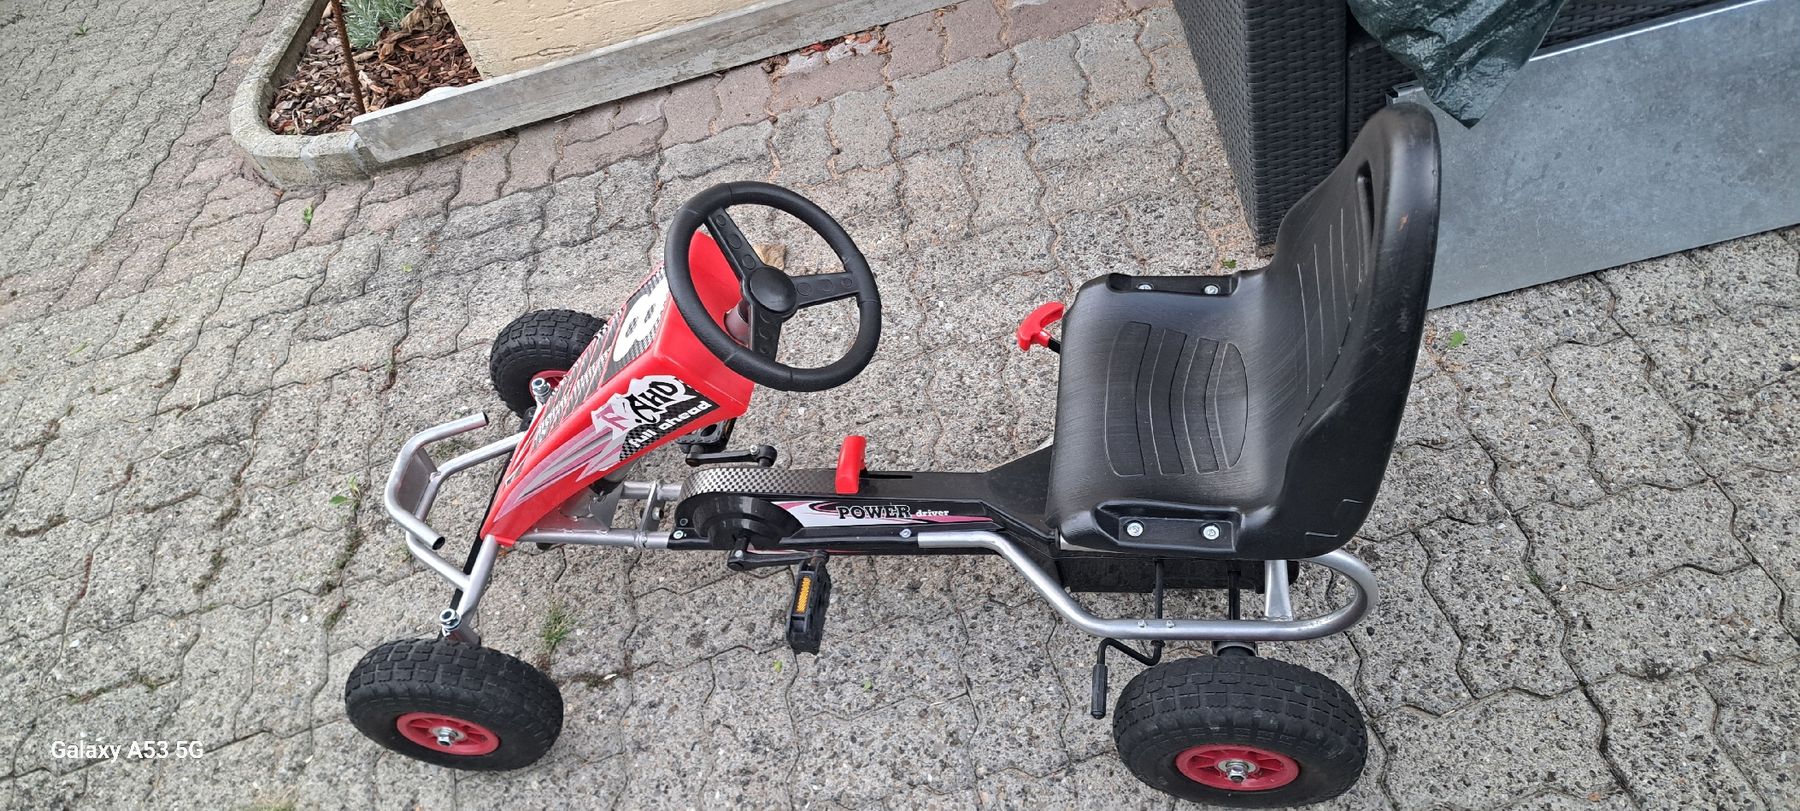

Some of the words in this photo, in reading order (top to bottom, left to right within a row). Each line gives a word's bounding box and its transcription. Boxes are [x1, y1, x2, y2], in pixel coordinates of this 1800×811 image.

[628, 429, 658, 448] full
[658, 400, 713, 431] ahead
[837, 505, 912, 520] POWER
[915, 509, 950, 518] driver
